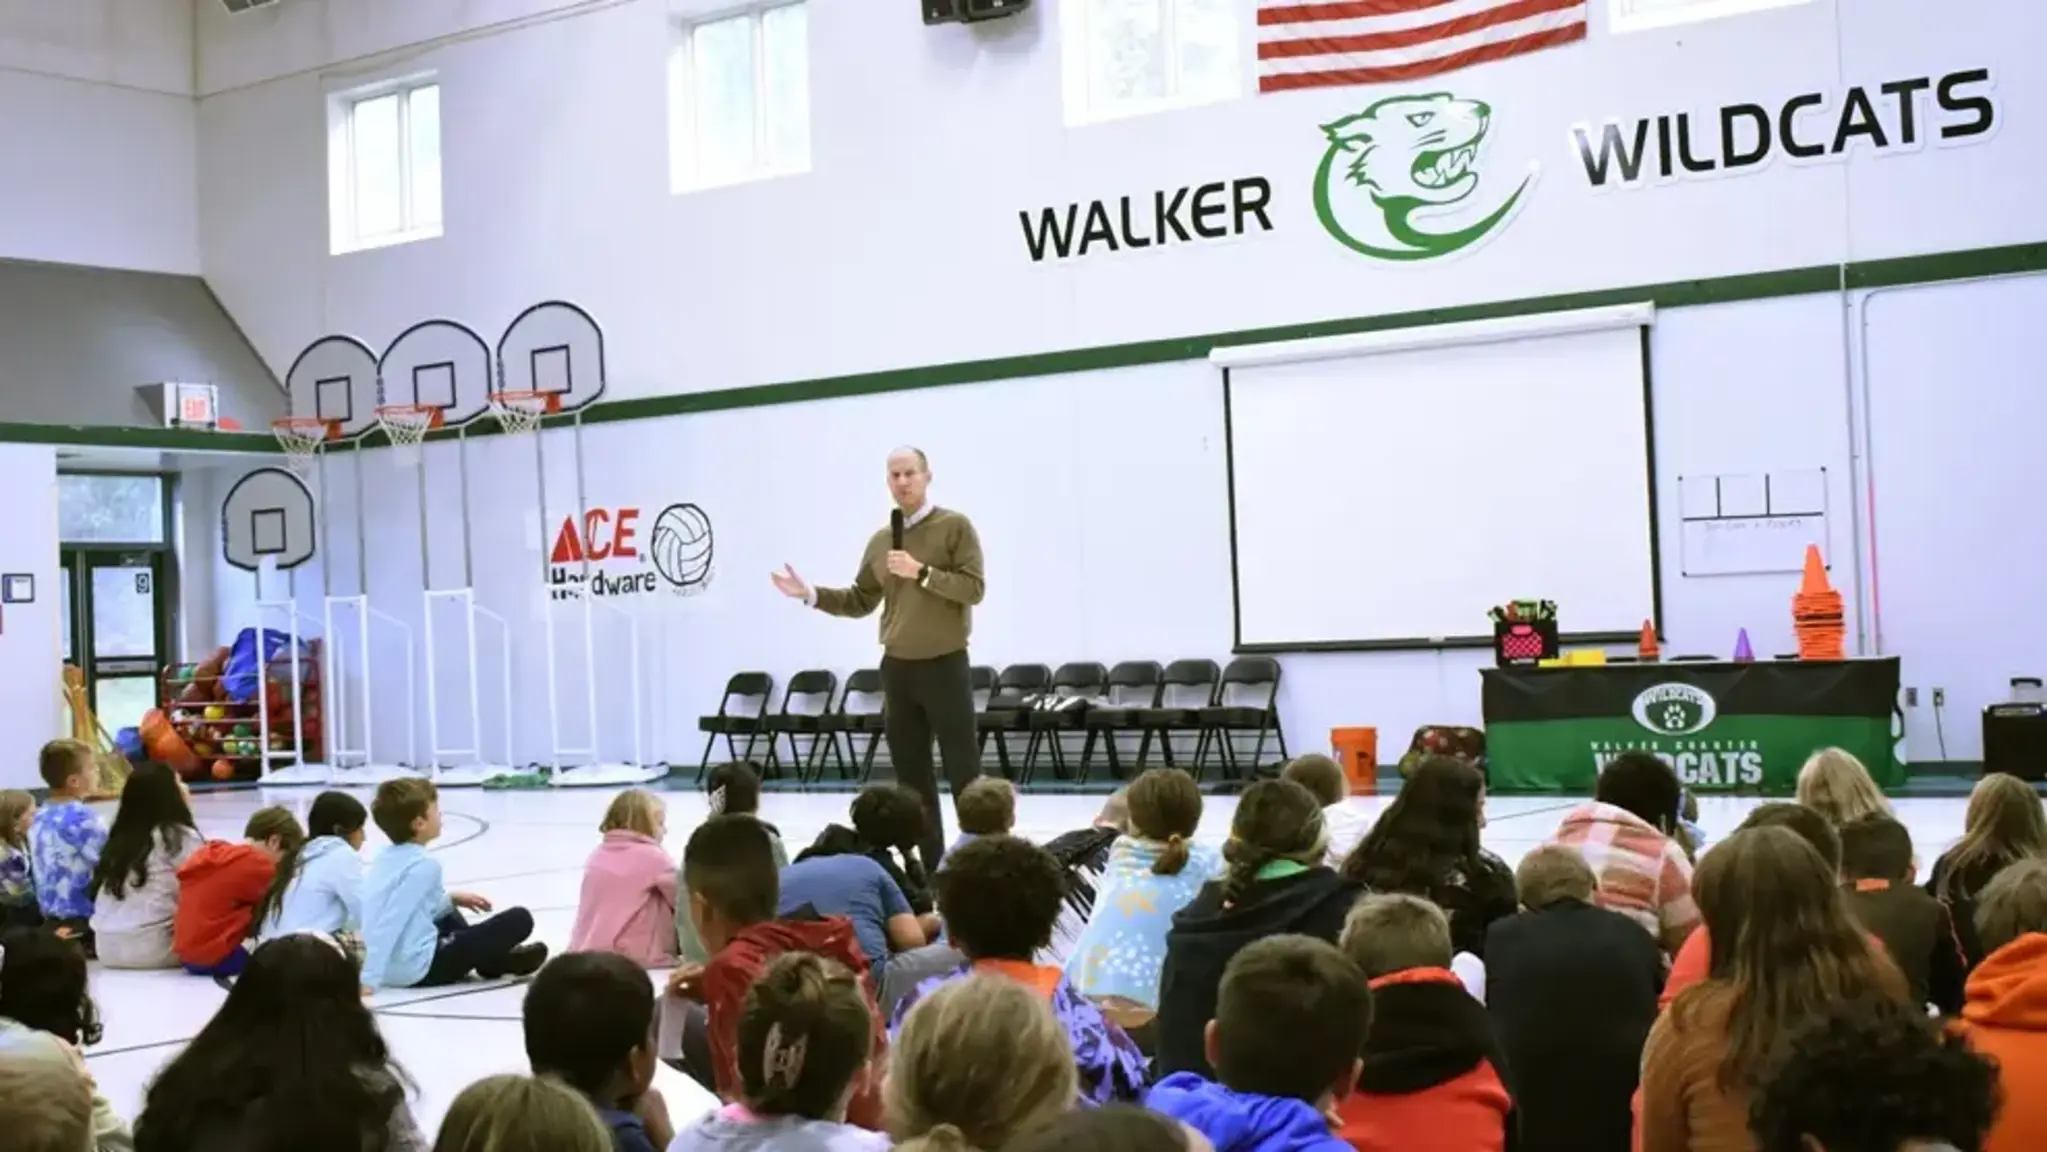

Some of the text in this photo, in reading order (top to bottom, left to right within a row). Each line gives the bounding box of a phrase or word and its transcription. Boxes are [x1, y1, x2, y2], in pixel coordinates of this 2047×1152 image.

[1019, 68, 1995, 262] WALKER WILDCATS
[551, 508, 639, 563] ACE
[1594, 752, 1763, 785] CATS
